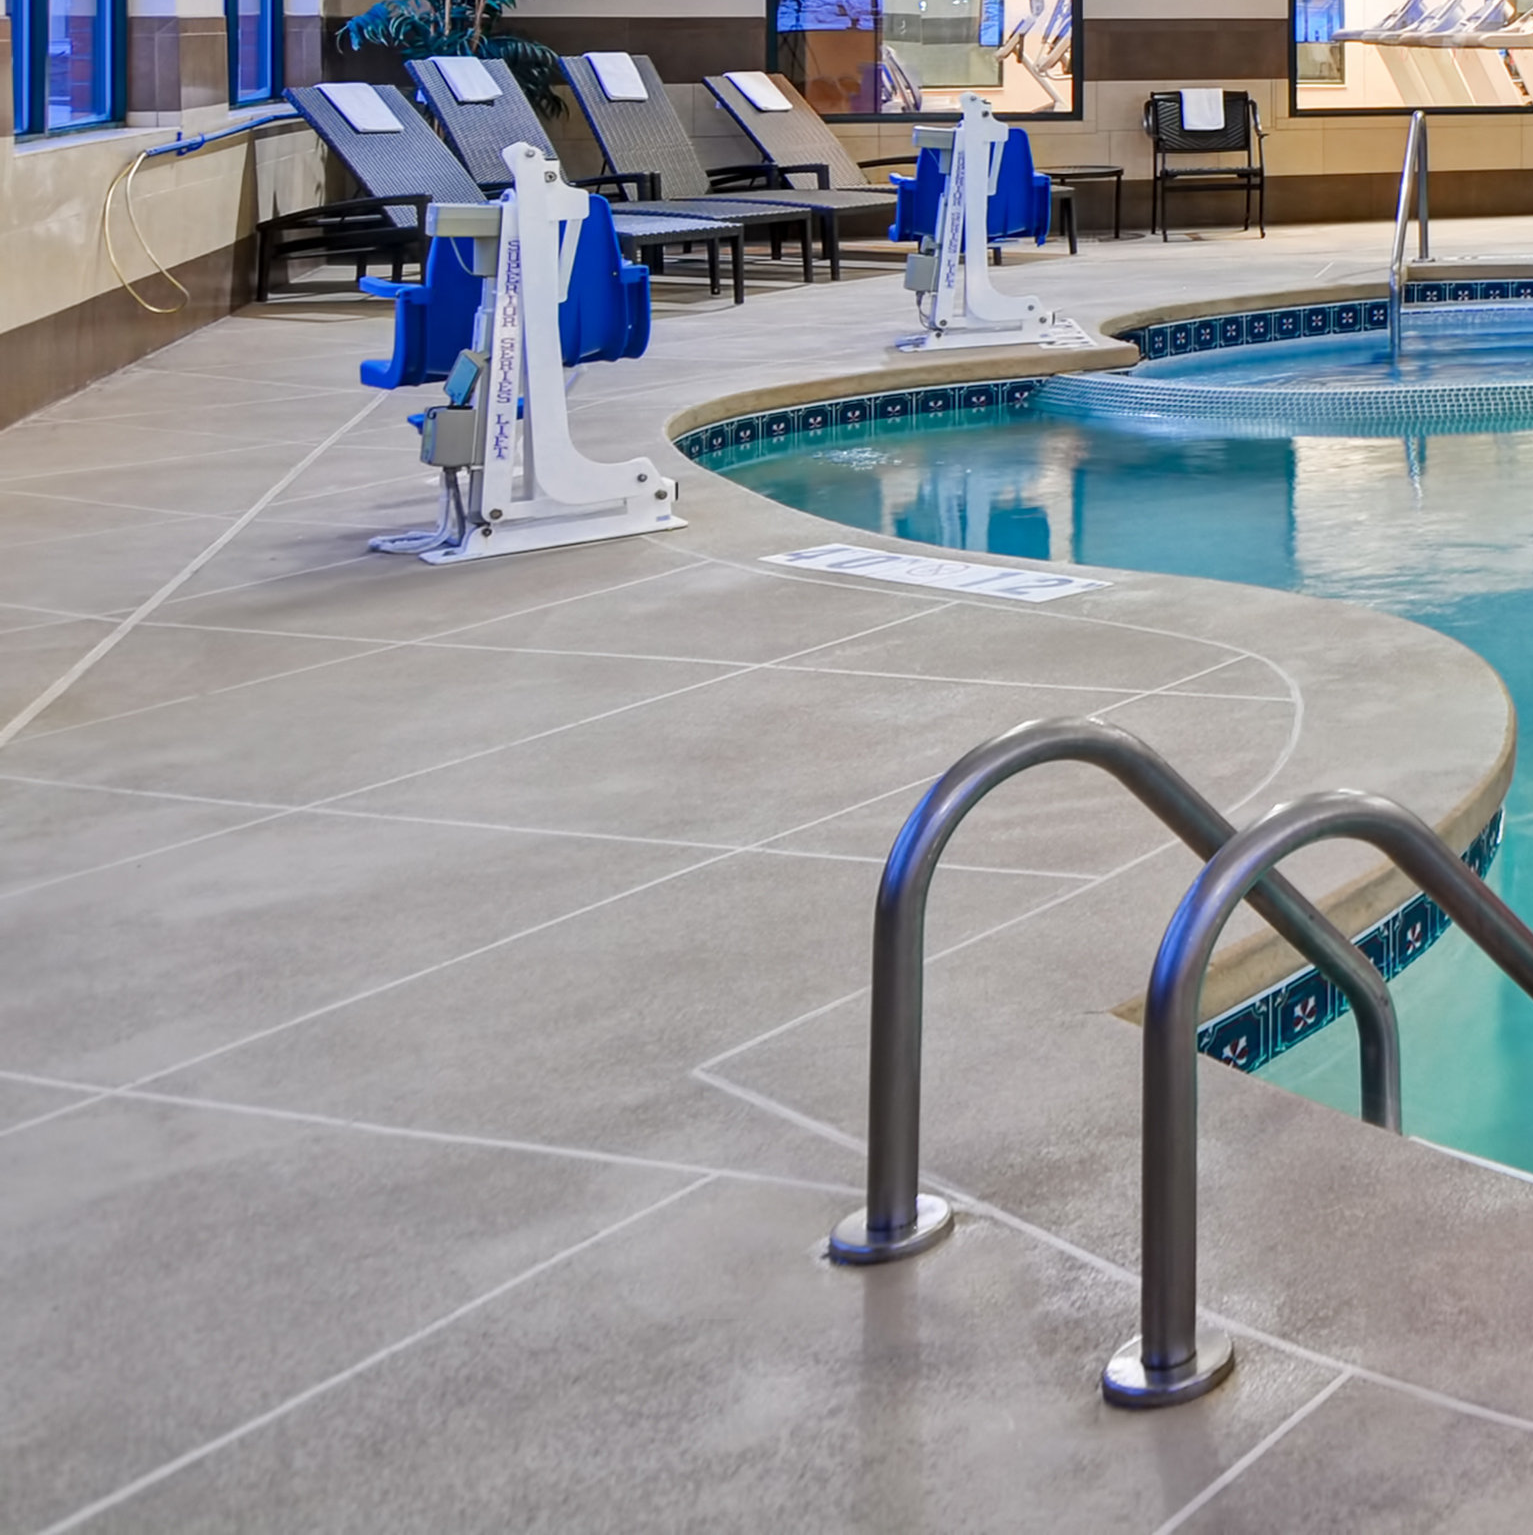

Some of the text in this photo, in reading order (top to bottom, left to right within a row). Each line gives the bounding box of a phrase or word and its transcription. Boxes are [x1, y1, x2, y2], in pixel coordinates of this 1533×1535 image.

[493, 240, 520, 460] SUPERIOR SERIES LIFT
